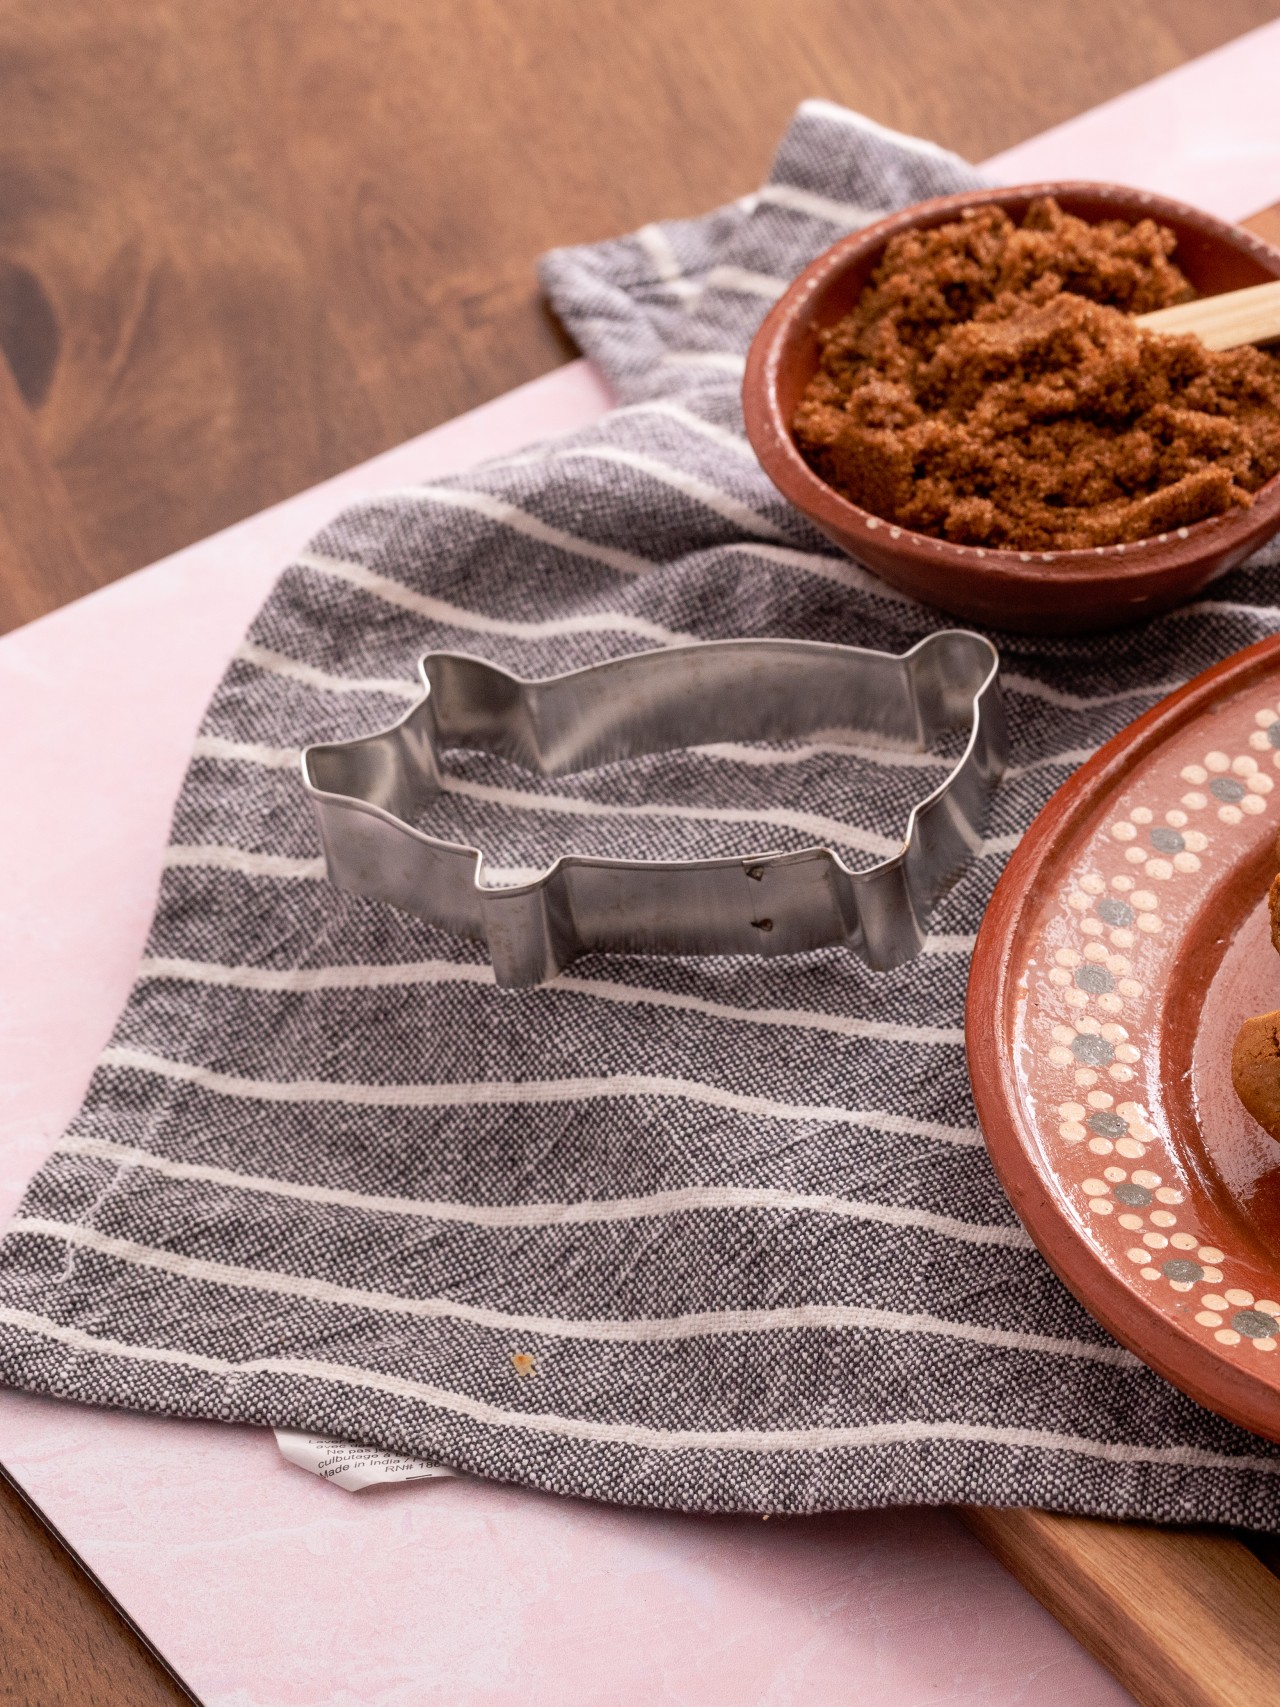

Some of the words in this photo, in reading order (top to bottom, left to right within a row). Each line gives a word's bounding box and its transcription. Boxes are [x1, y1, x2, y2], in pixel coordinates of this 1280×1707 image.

[318, 1453, 379, 1469] culbutage
[319, 1464, 350, 1479] Made
[370, 1458, 400, 1466] India
[385, 1463, 415, 1472] RN#
